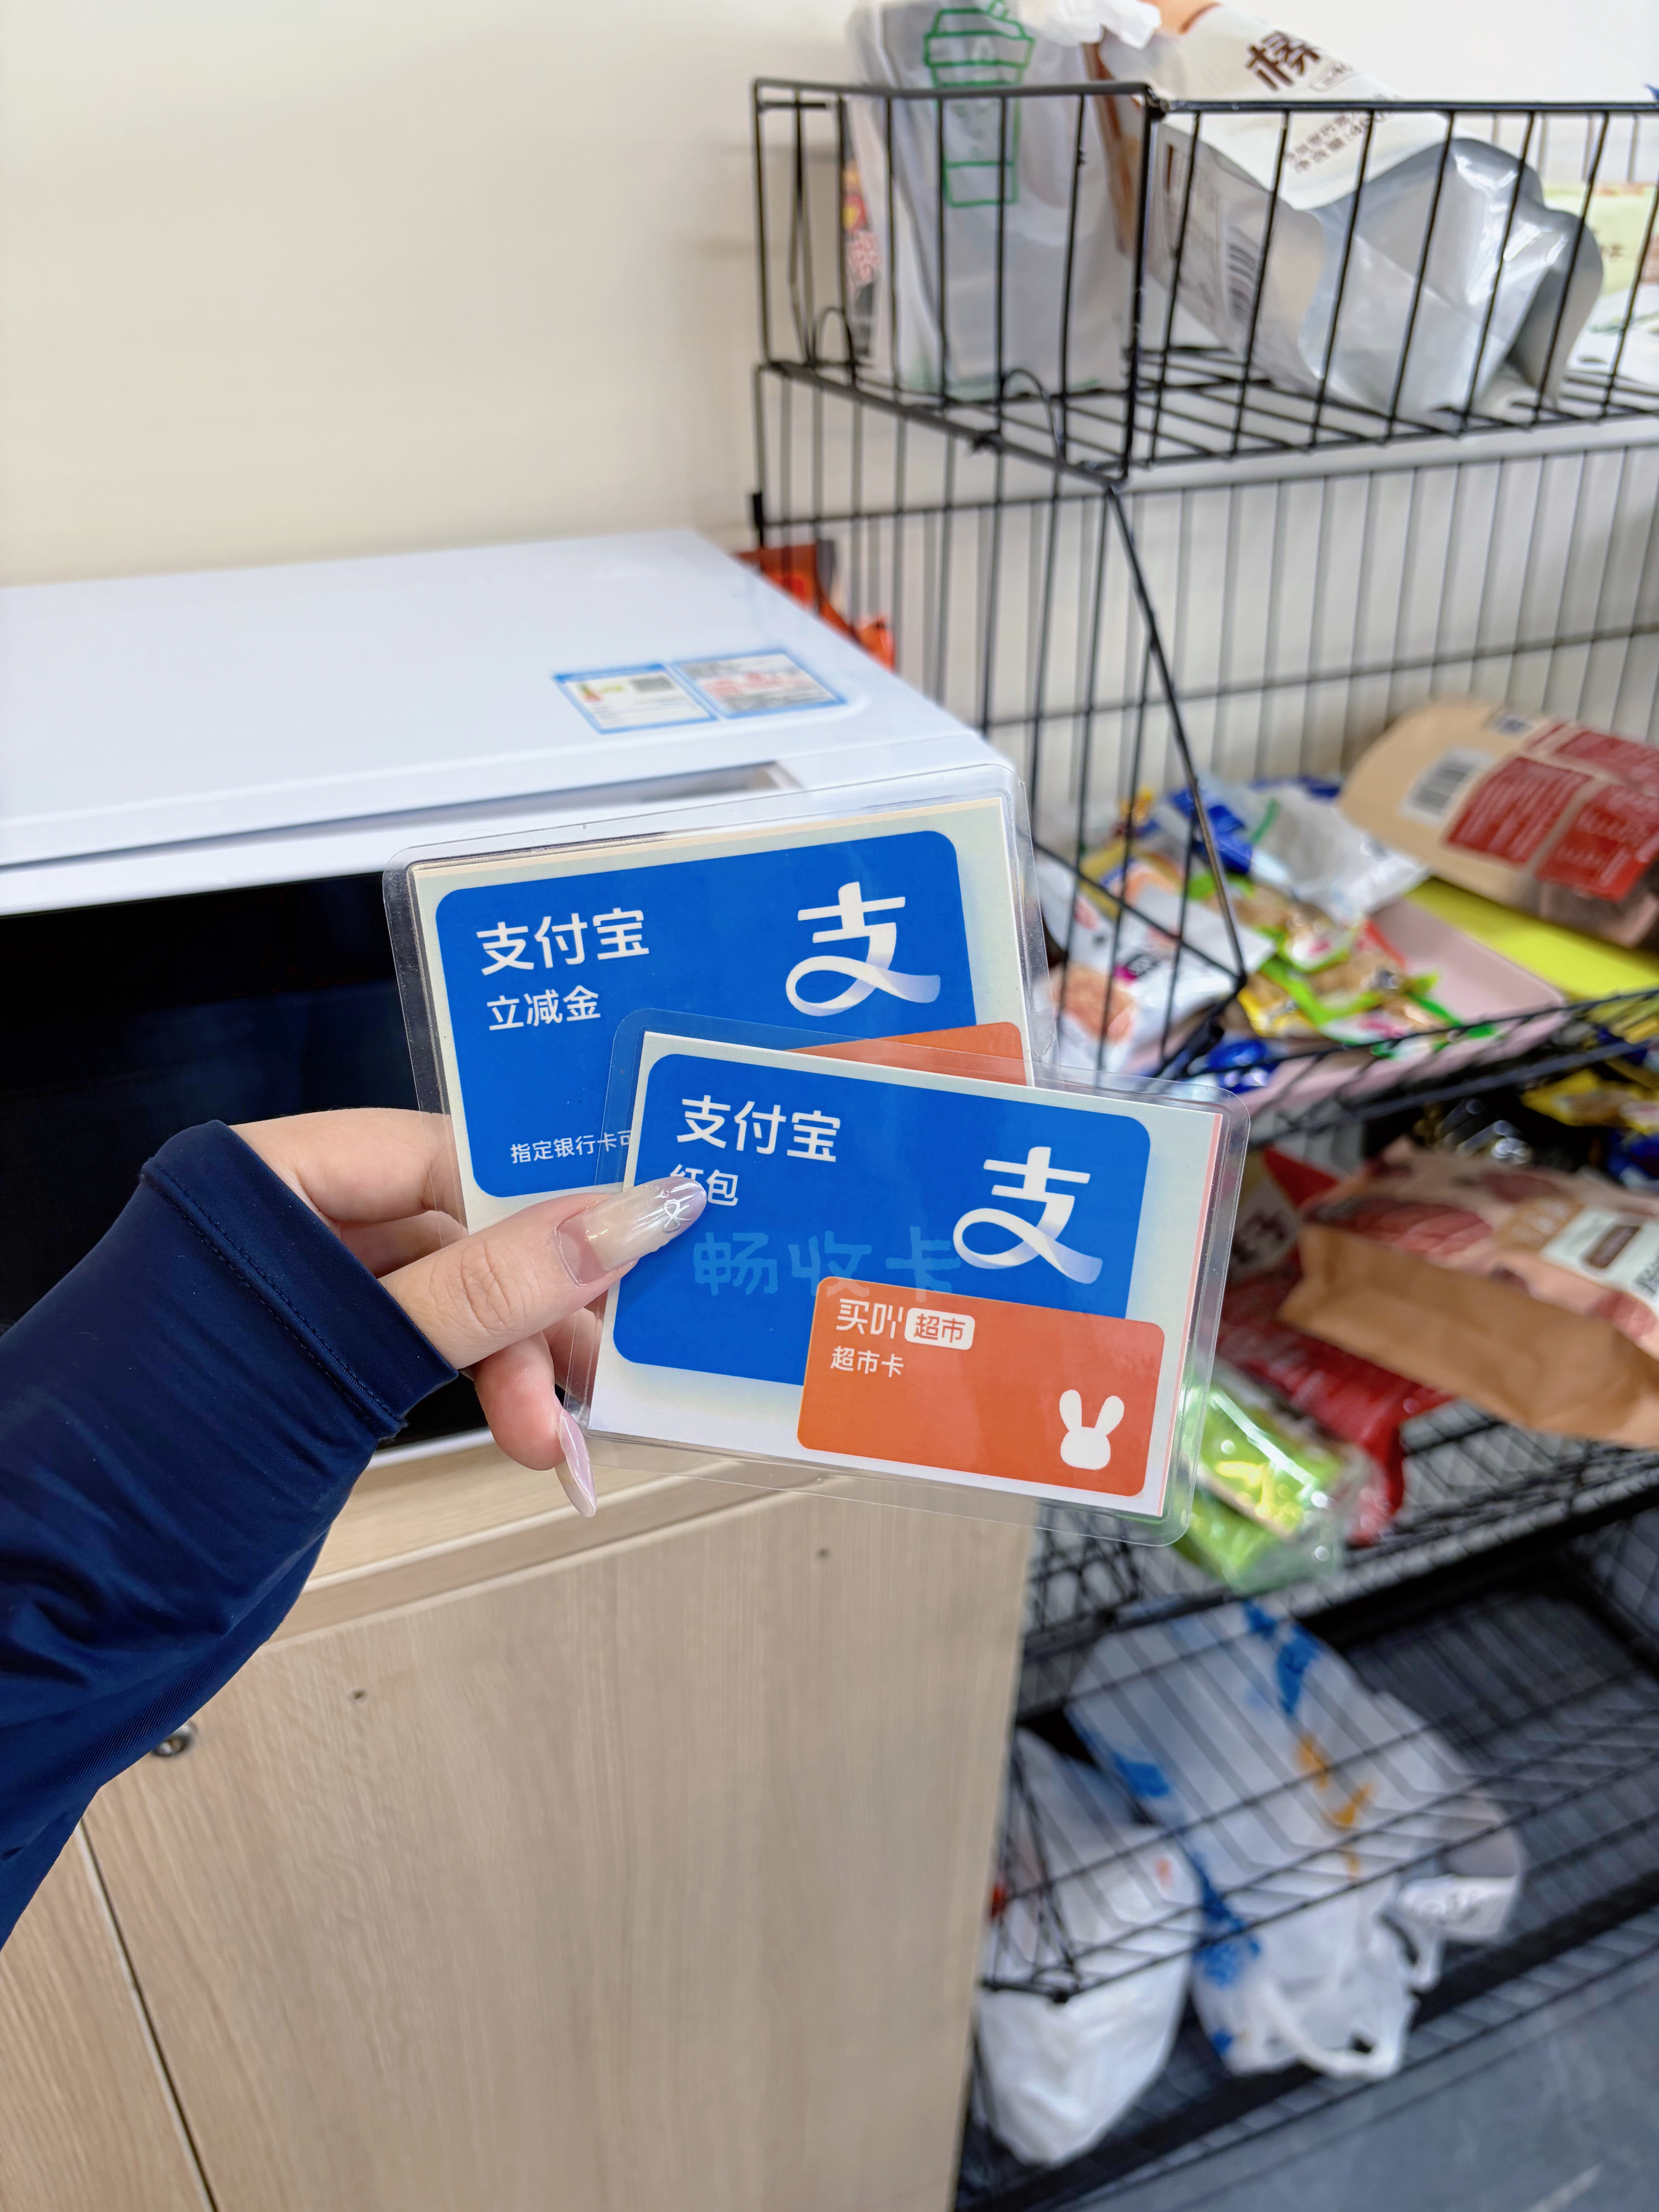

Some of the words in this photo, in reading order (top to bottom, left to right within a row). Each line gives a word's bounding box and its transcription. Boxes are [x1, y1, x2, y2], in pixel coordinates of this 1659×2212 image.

[476, 907, 650, 975] 支付宝
[785, 881, 941, 1017] 支
[486, 985, 601, 1030] 立减金
[676, 1095, 841, 1163] 支付宝
[953, 1146, 1103, 1285] 支
[830, 1345, 904, 1378] 超市卡
